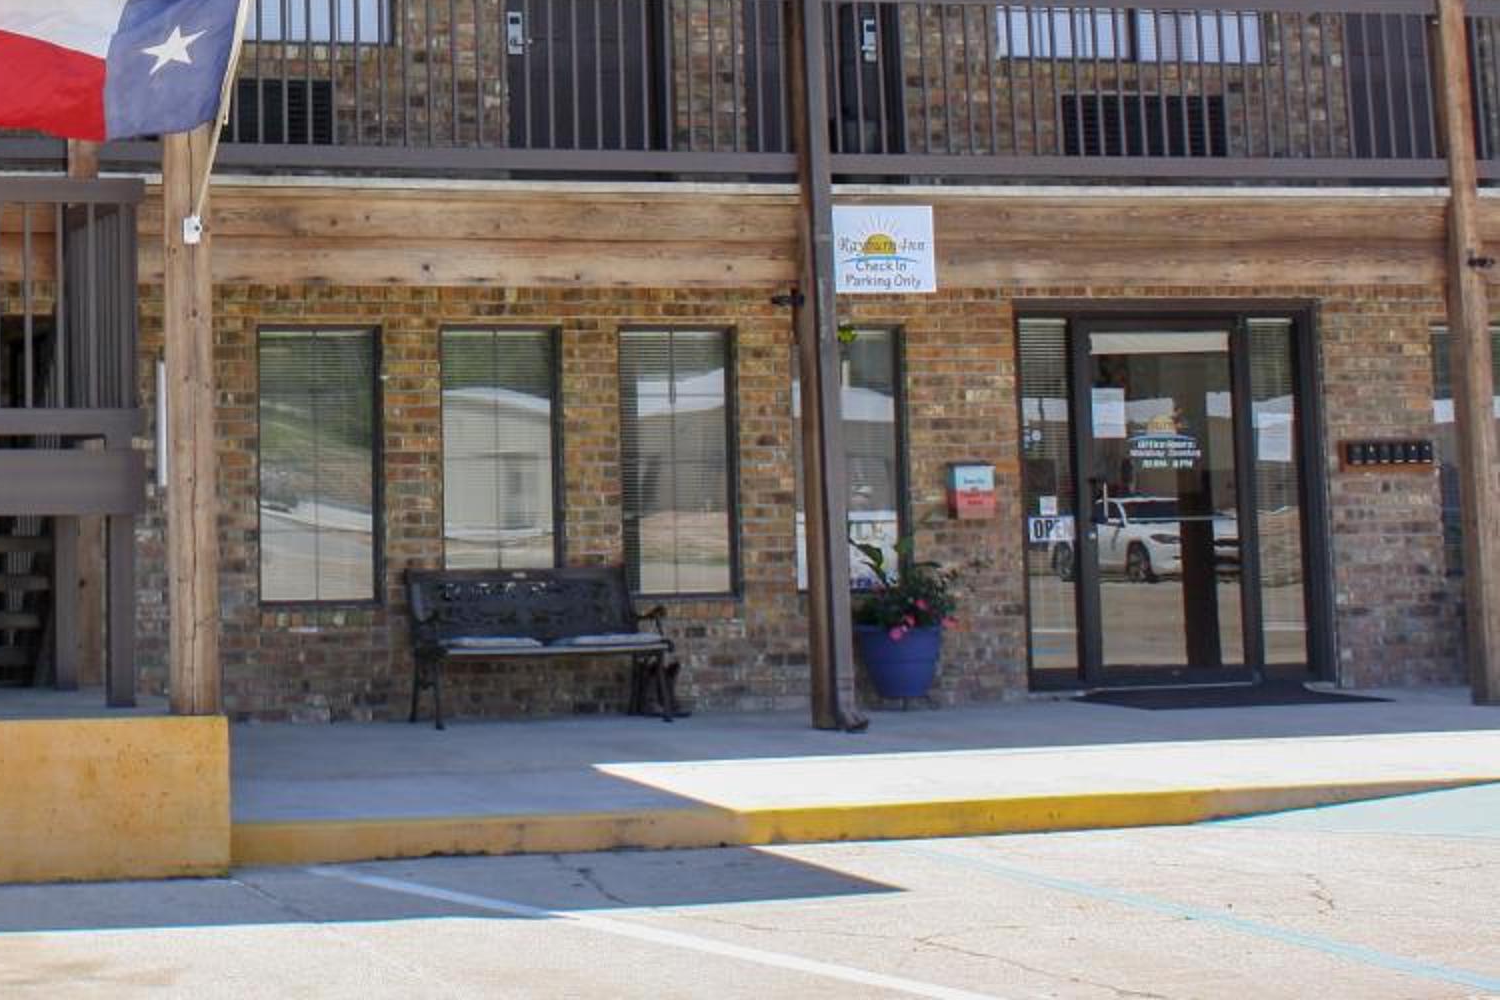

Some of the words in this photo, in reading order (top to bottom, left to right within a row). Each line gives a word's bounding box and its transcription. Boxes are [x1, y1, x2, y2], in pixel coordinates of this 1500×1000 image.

[855, 260, 893, 272] Check
[845, 274, 891, 290] Parking
[894, 274, 921, 290] Only
